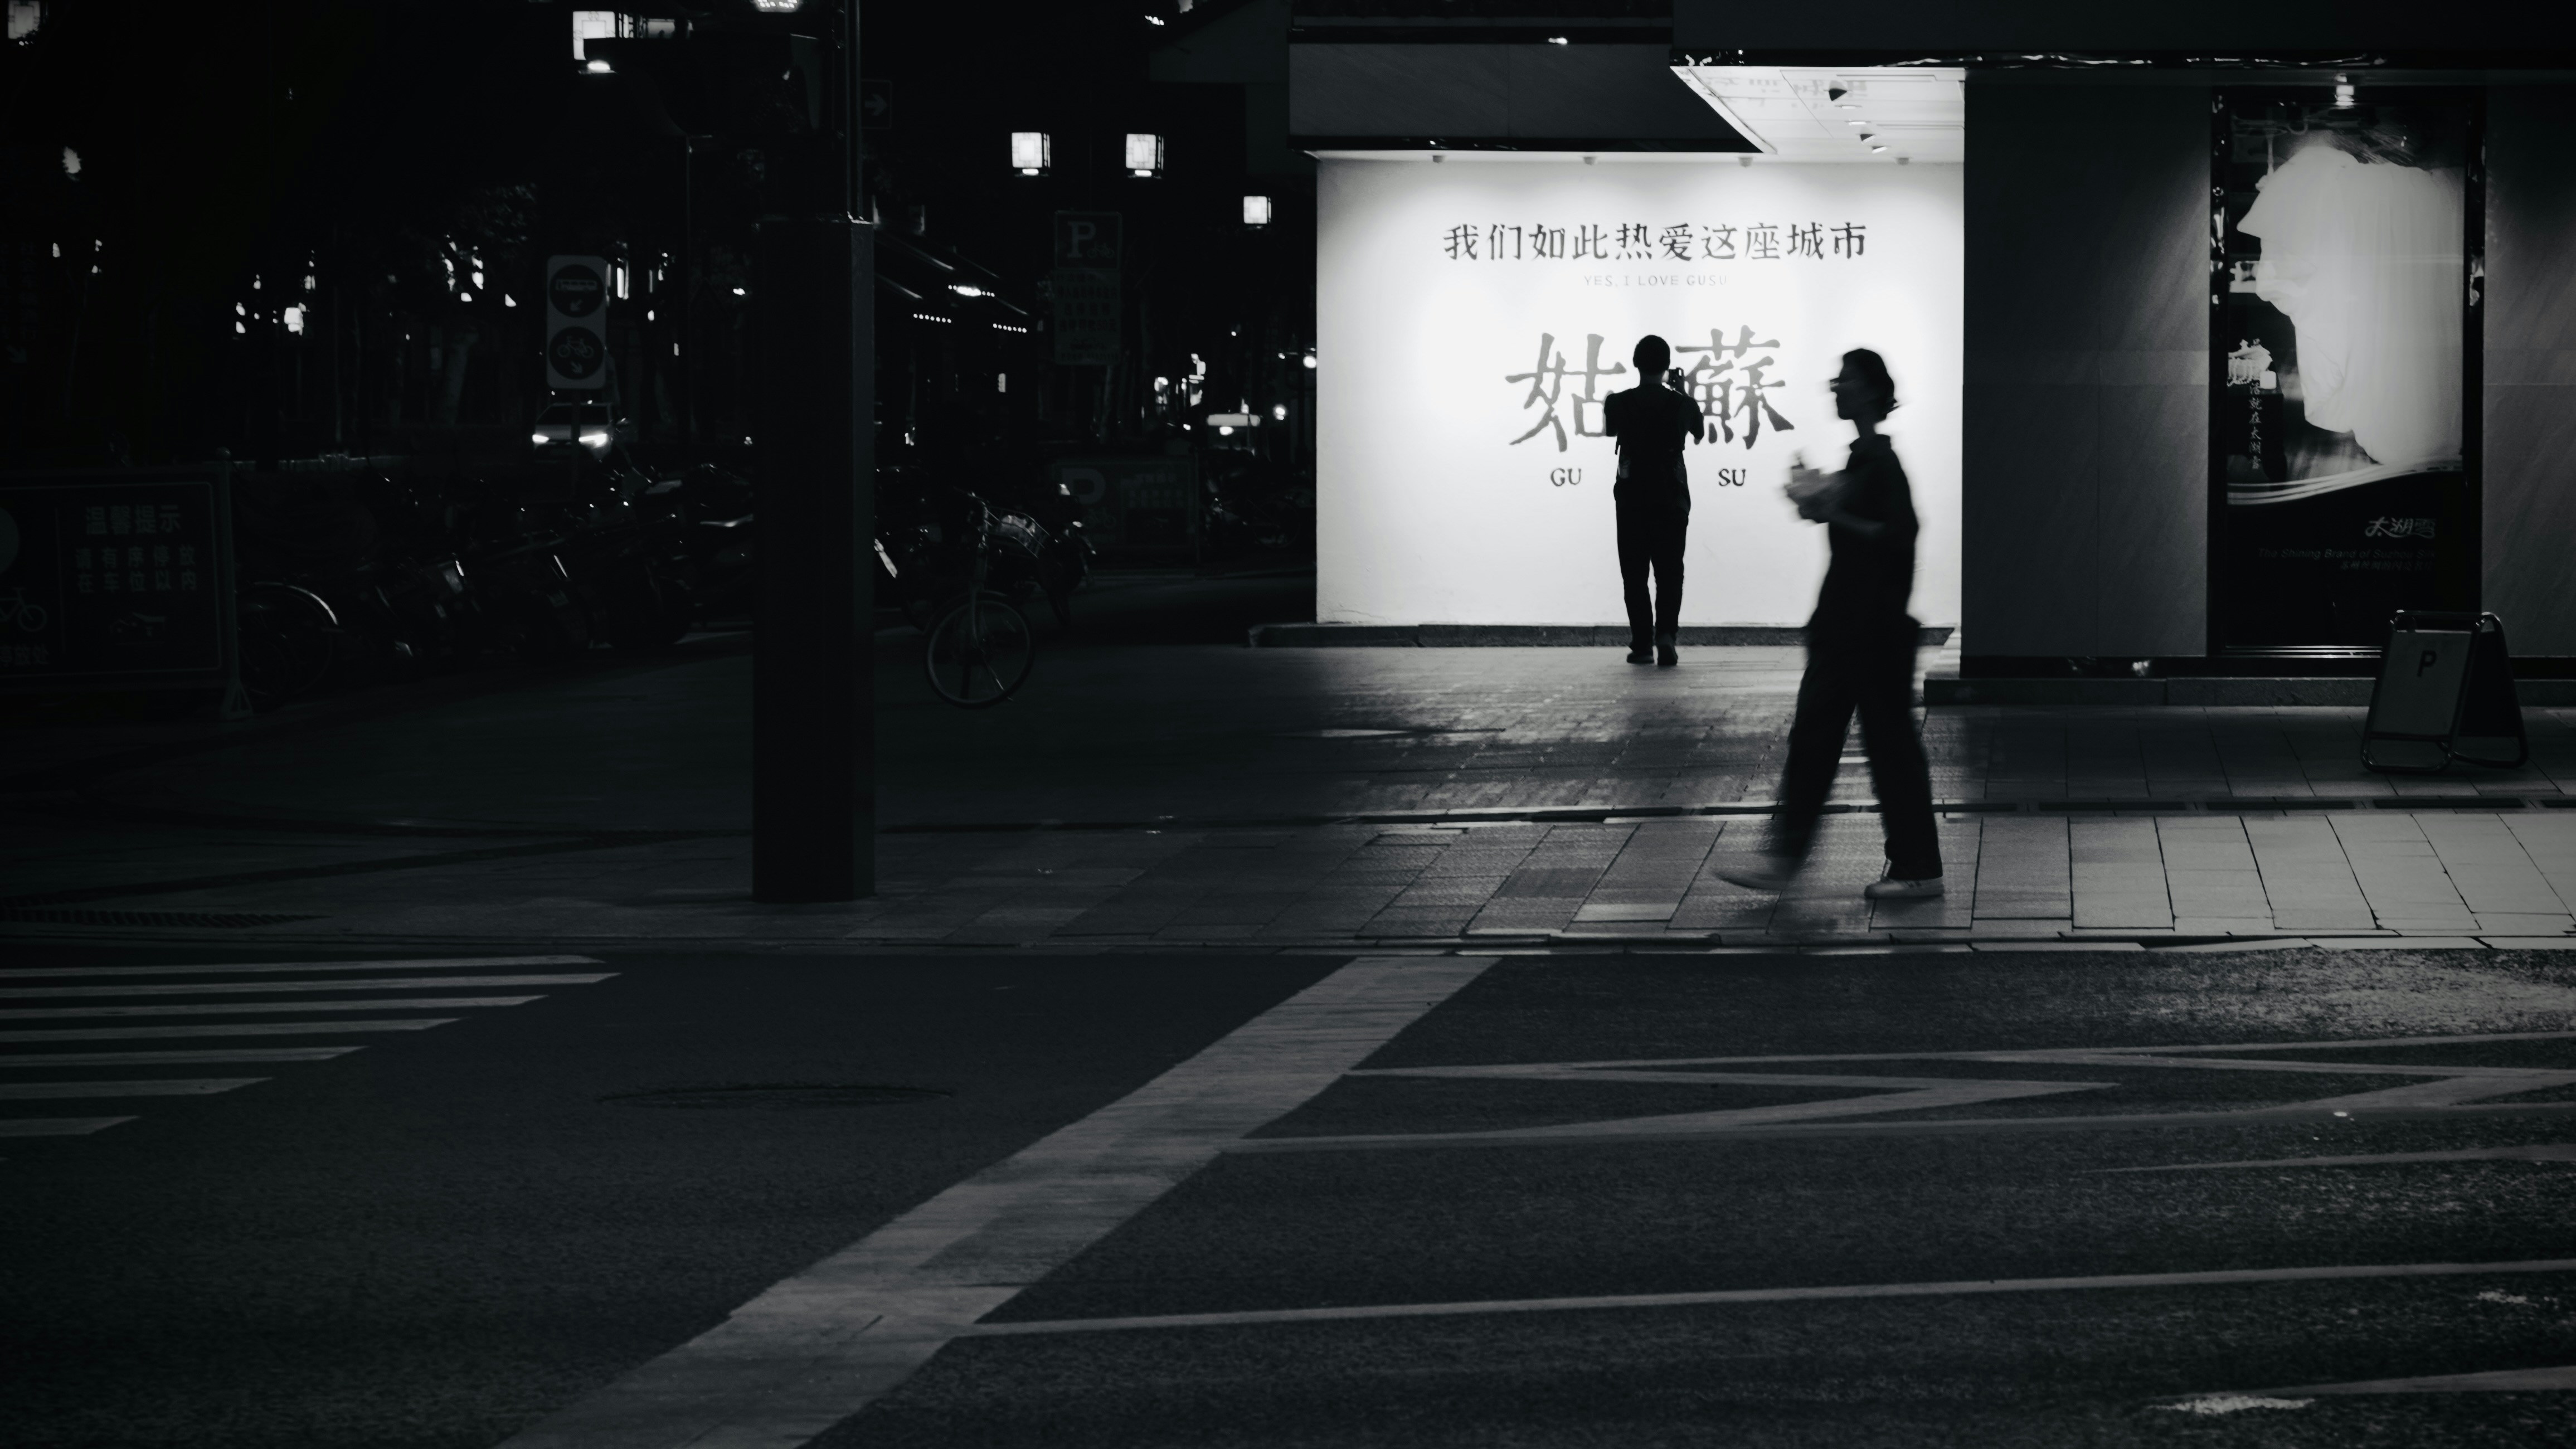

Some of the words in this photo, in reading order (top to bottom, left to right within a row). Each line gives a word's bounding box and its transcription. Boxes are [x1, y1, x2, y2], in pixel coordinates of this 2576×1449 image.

[1067, 221, 1097, 259] P
[1443, 221, 1867, 262] 我们如此热爱这座城市
[1637, 274, 1680, 287] LOVE
[1686, 274, 1728, 287] GUSU
[1550, 468, 1582, 487] GU
[1718, 468, 1747, 487] SU
[86, 504, 181, 535] 温馨提示
[2281, 548, 2321, 560] Shining
[2324, 548, 2358, 558] Brand
[2359, 548, 2371, 558] of
[2417, 650, 2437, 677] P
